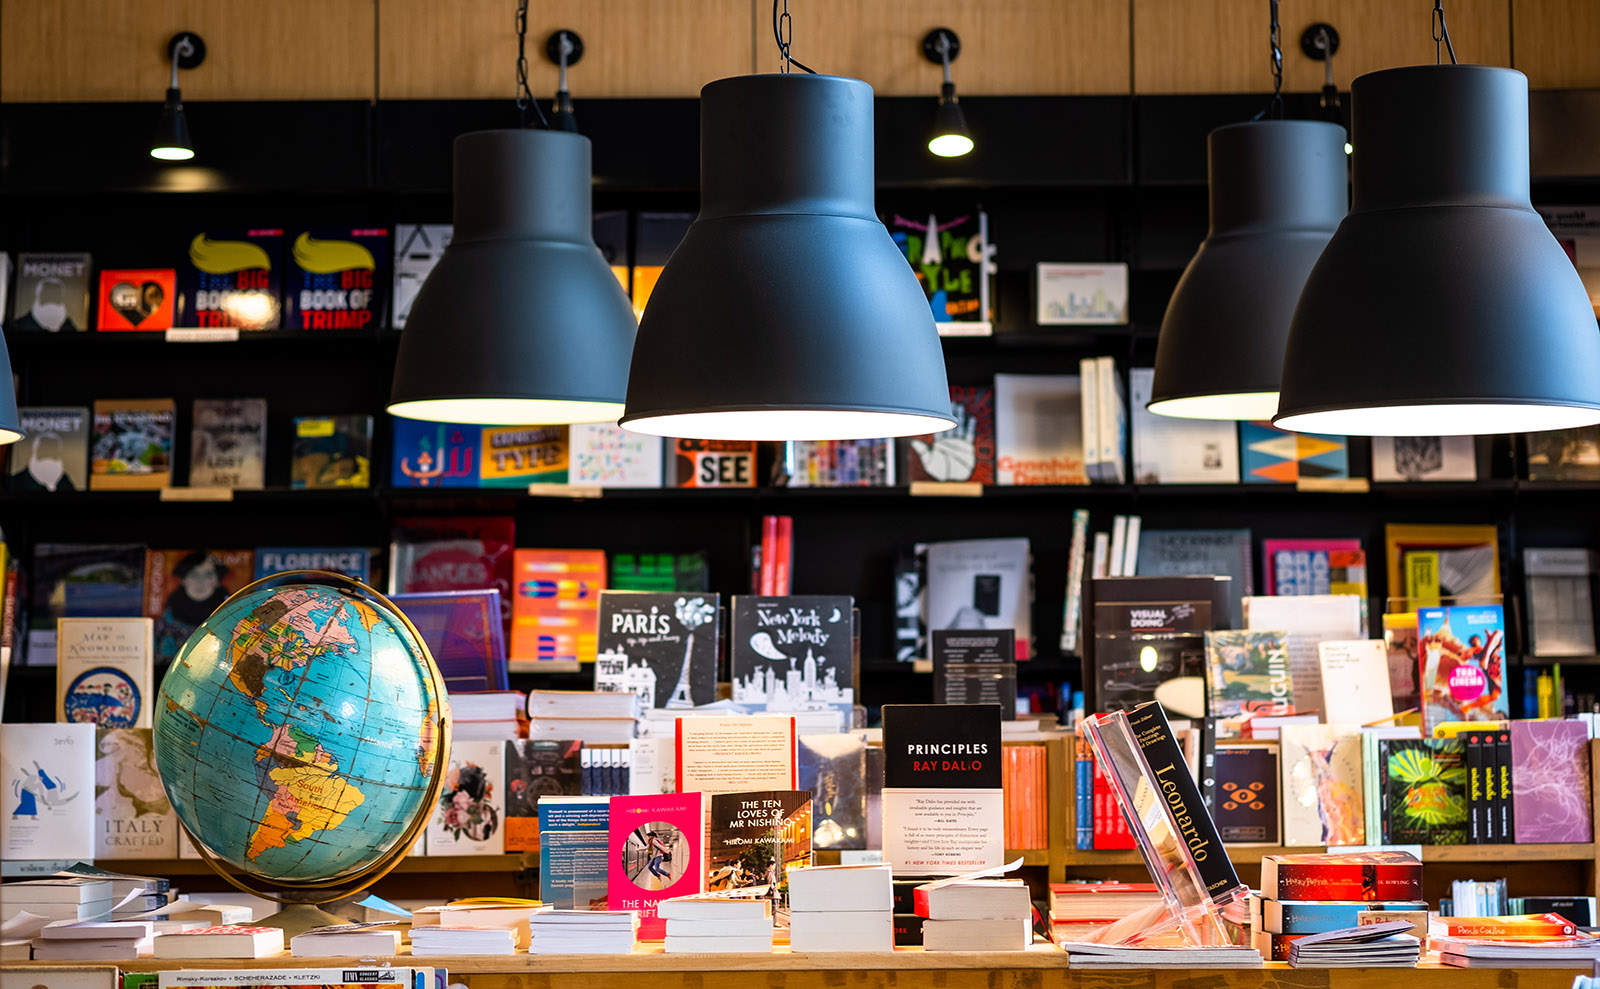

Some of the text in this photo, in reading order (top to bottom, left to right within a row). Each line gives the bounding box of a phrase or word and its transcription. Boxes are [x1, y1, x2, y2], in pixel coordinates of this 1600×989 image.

[24, 263, 85, 276] MONET
[237, 270, 269, 289] BIG
[341, 270, 373, 289] BIG
[300, 290, 373, 310] BOOK OF
[302, 311, 372, 329] TRUMP
[21, 418, 82, 431] MONET
[493, 445, 561, 469] TYPE
[701, 456, 748, 483] SEE
[263, 553, 362, 571] FLORENCE
[757, 608, 821, 627] New York
[1130, 609, 1167, 619] VISUAL
[1131, 619, 1164, 628] DOING
[777, 627, 830, 647] Melody
[1455, 667, 1477, 678] THAI
[1450, 676, 1483, 688] CINEMA
[1142, 725, 1161, 736] Complete
[364, 735, 394, 750] Atlantic
[1145, 734, 1166, 746] Drawings
[908, 743, 988, 755] PRINCIPLES
[913, 760, 982, 771] RAY DALIO
[297, 780, 323, 794] South
[288, 794, 322, 810] America
[741, 800, 782, 810] THE TEN
[737, 809, 785, 818] LOVES OF
[1155, 762, 1209, 862] Leonardo
[105, 820, 164, 833] ITALY
[729, 818, 792, 828] MR NISHINO
[105, 836, 164, 846] CRAFTED
[726, 838, 753, 846] HIROMI
[1285, 878, 1330, 886] HARRY POTTER
[622, 900, 640, 908] THE
[1457, 926, 1506, 935] Paulo Coelho
[234, 974, 287, 982] SCHEHERAZADE
